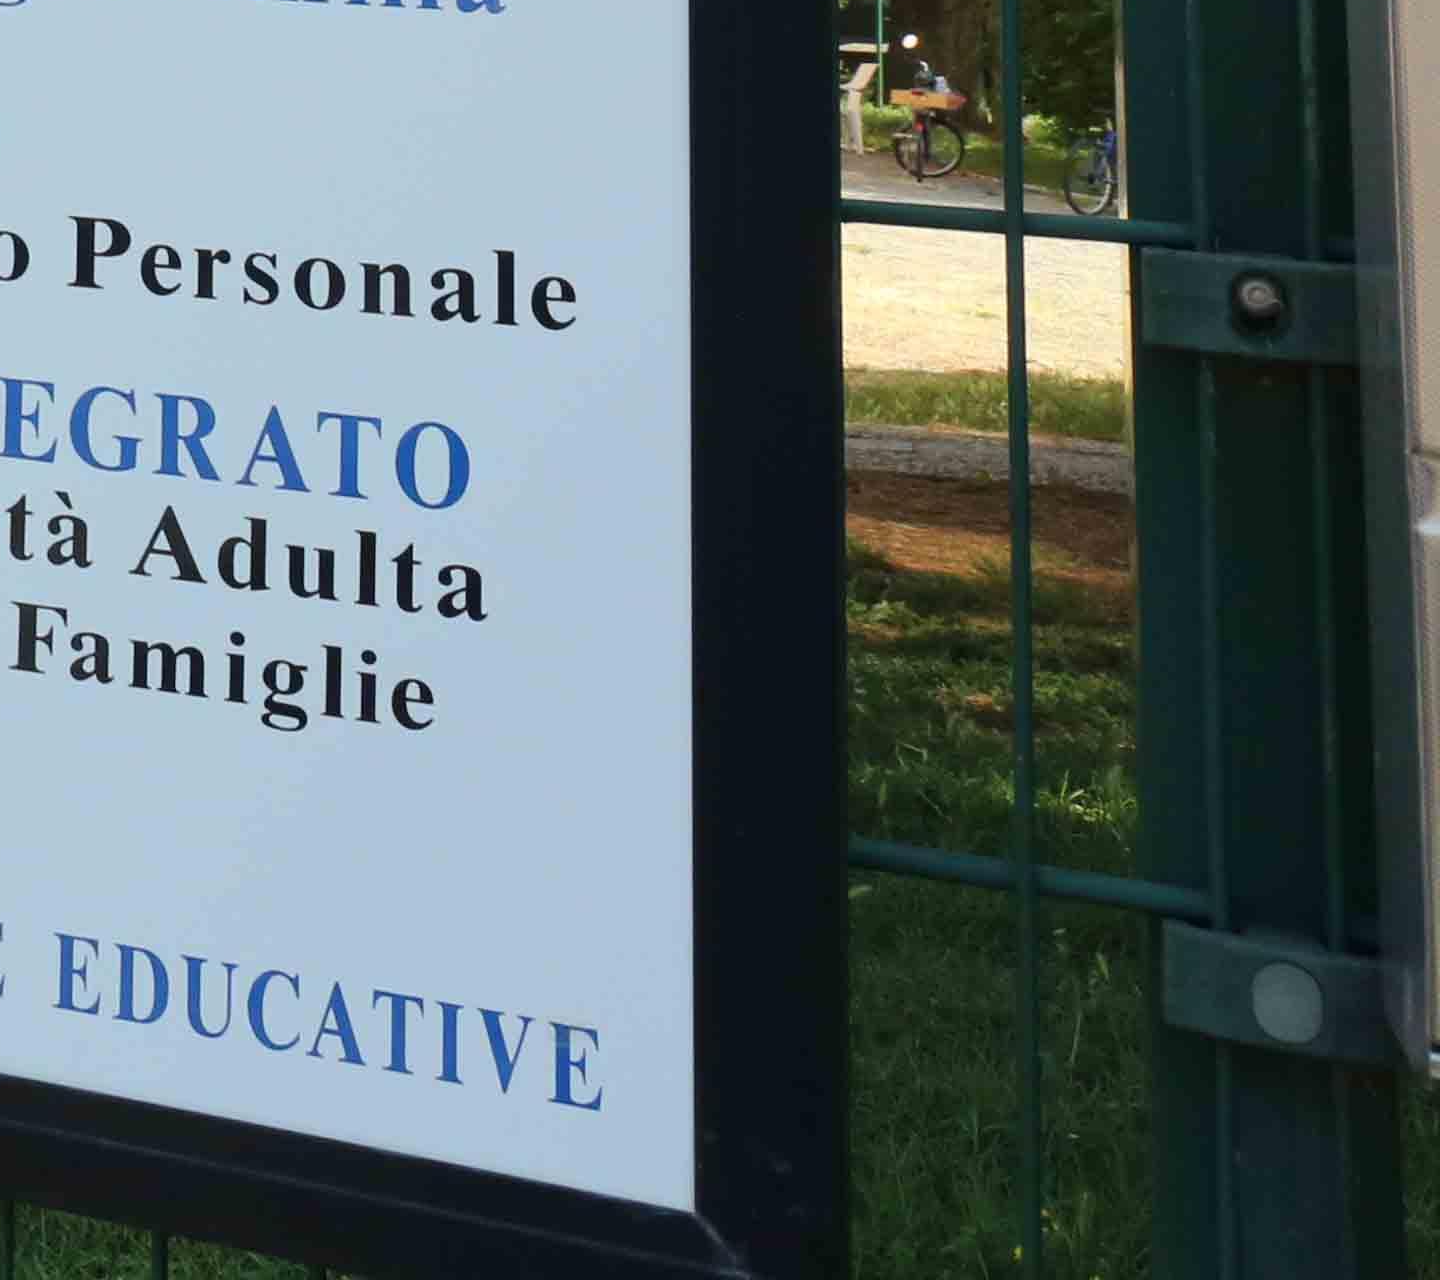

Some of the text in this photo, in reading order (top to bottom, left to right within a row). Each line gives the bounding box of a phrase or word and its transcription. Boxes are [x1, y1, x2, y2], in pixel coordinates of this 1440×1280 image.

[68, 216, 576, 330] Personale
[128, 505, 488, 622] Adulta
[9, 601, 434, 731] Famiglie
[54, 933, 602, 1111] EDUCATIVE
